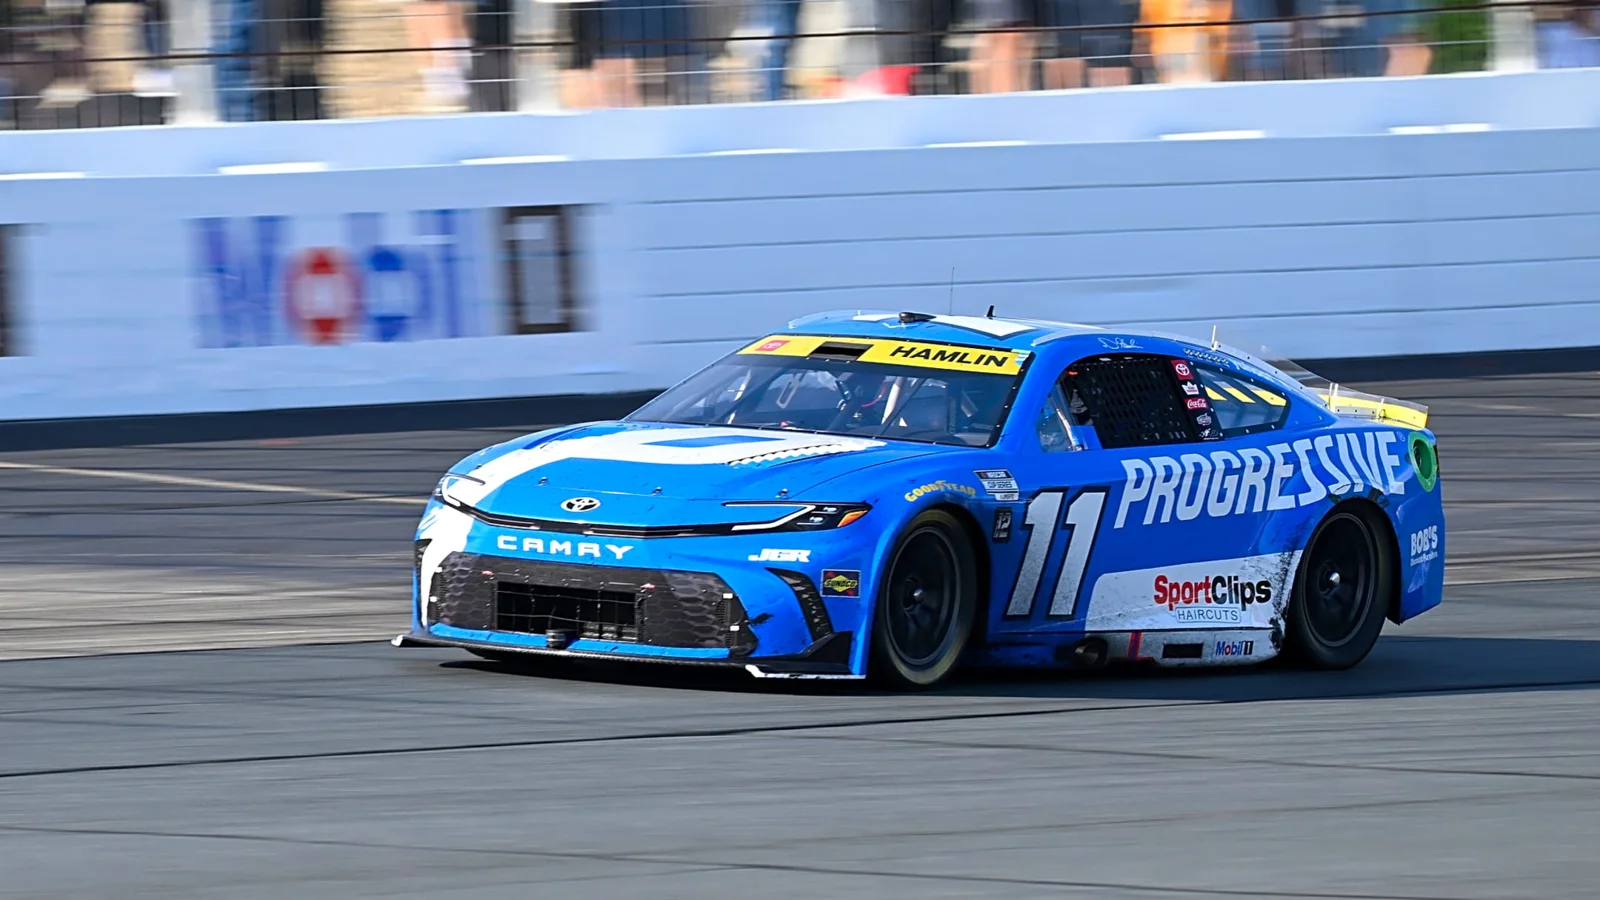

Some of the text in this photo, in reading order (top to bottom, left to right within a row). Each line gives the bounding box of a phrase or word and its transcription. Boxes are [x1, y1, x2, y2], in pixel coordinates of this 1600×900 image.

[890, 345, 1008, 367] HAMLIN
[904, 480, 976, 502] GOODYEAR
[1113, 431, 1405, 529] PROGRESSIVE
[497, 535, 634, 560] CAMRY
[1410, 525, 1438, 557] BOB'S
[748, 548, 811, 562] JGR
[1005, 489, 1108, 617] 11
[824, 579, 858, 588] SUNOCO
[1177, 609, 1238, 621] HAIRCUTS
[1215, 641, 1254, 655] Mobil 1
